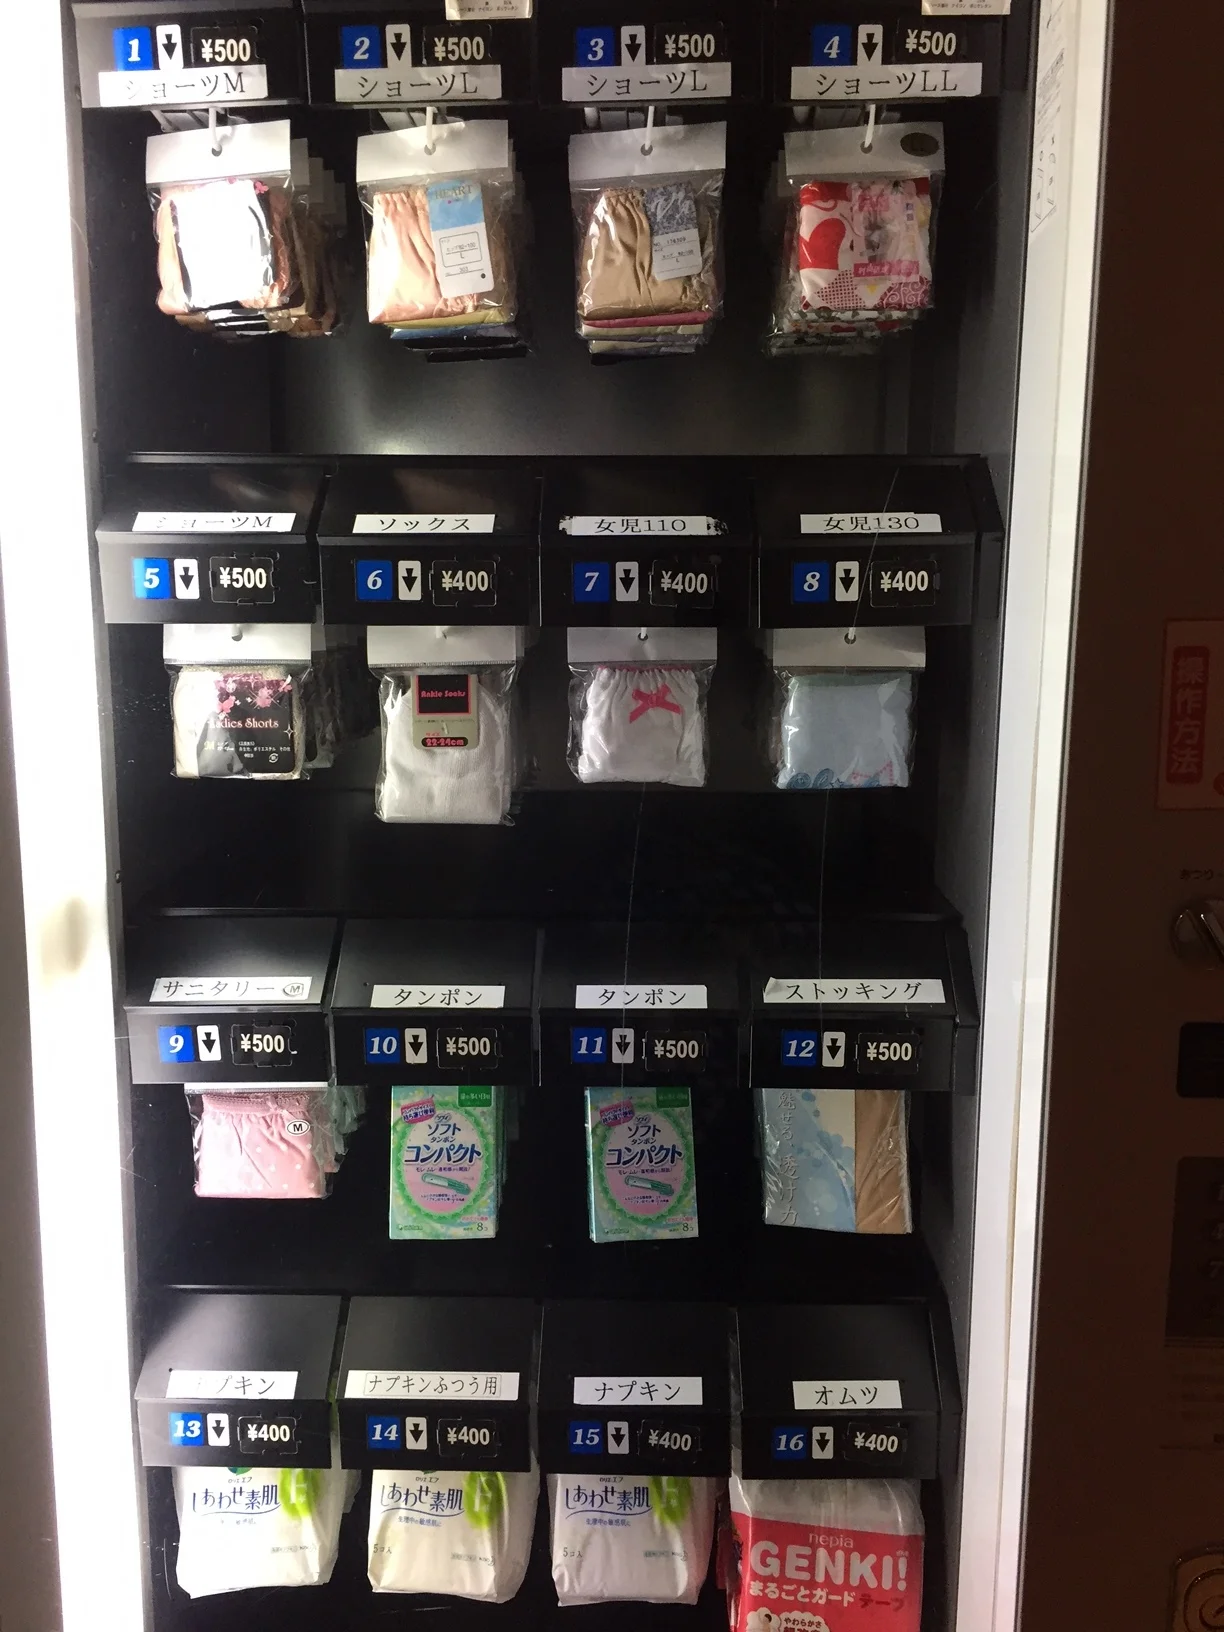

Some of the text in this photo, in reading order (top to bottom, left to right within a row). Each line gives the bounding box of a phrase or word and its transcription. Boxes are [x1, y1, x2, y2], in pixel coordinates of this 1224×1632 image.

[127, 38, 141, 62] 1
[201, 38, 250, 63] ¥500
[353, 37, 370, 60] 2
[434, 36, 484, 61] ¥500
[587, 38, 604, 60] 3
[664, 33, 715, 58] ¥500
[823, 36, 841, 59] 4
[905, 29, 956, 56] ¥500
[357, 72, 478, 99] ショーツL
[586, 69, 707, 97] ショーツL
[816, 68, 958, 96] ショーツLL
[378, 517, 471, 532] ソックス
[594, 518, 686, 533] 女児110
[823, 515, 919, 531] 女児130
[143, 567, 160, 589] 5
[219, 566, 267, 589] ¥500
[366, 569, 383, 590] 6
[441, 570, 489, 592] ¥400
[583, 571, 599, 592] 7
[660, 571, 708, 594] ¥400
[803, 571, 819, 592] 8
[880, 570, 928, 592] ¥400
[245, 717, 279, 729] Shorts
[1172, 656, 1206, 775] 操作方法
[394, 988, 482, 1006] タンポン
[598, 988, 686, 1006] タンポン
[786, 981, 921, 1001] ストッキング
[169, 1034, 185, 1053] 9
[240, 1033, 285, 1053] ¥500
[369, 1036, 397, 1055] 10
[446, 1036, 491, 1056] ¥500
[577, 1036, 604, 1054] 11
[654, 1038, 699, 1059] ¥500
[786, 1039, 814, 1058] 12
[866, 1041, 912, 1061] ¥500
[293, 1122, 303, 1133] M
[427, 1123, 461, 1137] ソフト
[627, 1124, 662, 1138] ソフト
[404, 1143, 482, 1163] コンパクト
[606, 1143, 683, 1166] コンパクト
[368, 1374, 498, 1397] ナプキンふつう用
[594, 1381, 682, 1402] ナプキン
[815, 1385, 879, 1406] オムツ
[173, 1419, 201, 1438] 13
[247, 1423, 290, 1442] ¥400
[372, 1424, 398, 1441] 14
[447, 1425, 490, 1445] ¥400
[573, 1428, 600, 1445] 15
[648, 1429, 691, 1451] ¥400
[776, 1434, 804, 1451] 16
[854, 1432, 899, 1454] ¥400
[192, 1484, 280, 1513] しあわせ素肌
[380, 1482, 464, 1512] しあわせ素肌
[565, 1484, 651, 1512] しあわせ素肌
[808, 1532, 854, 1549] nepia
[750, 1540, 908, 1592] GENKI!
[750, 1580, 856, 1608] まるごとガード
[783, 1617, 822, 1629] やわらかさ
